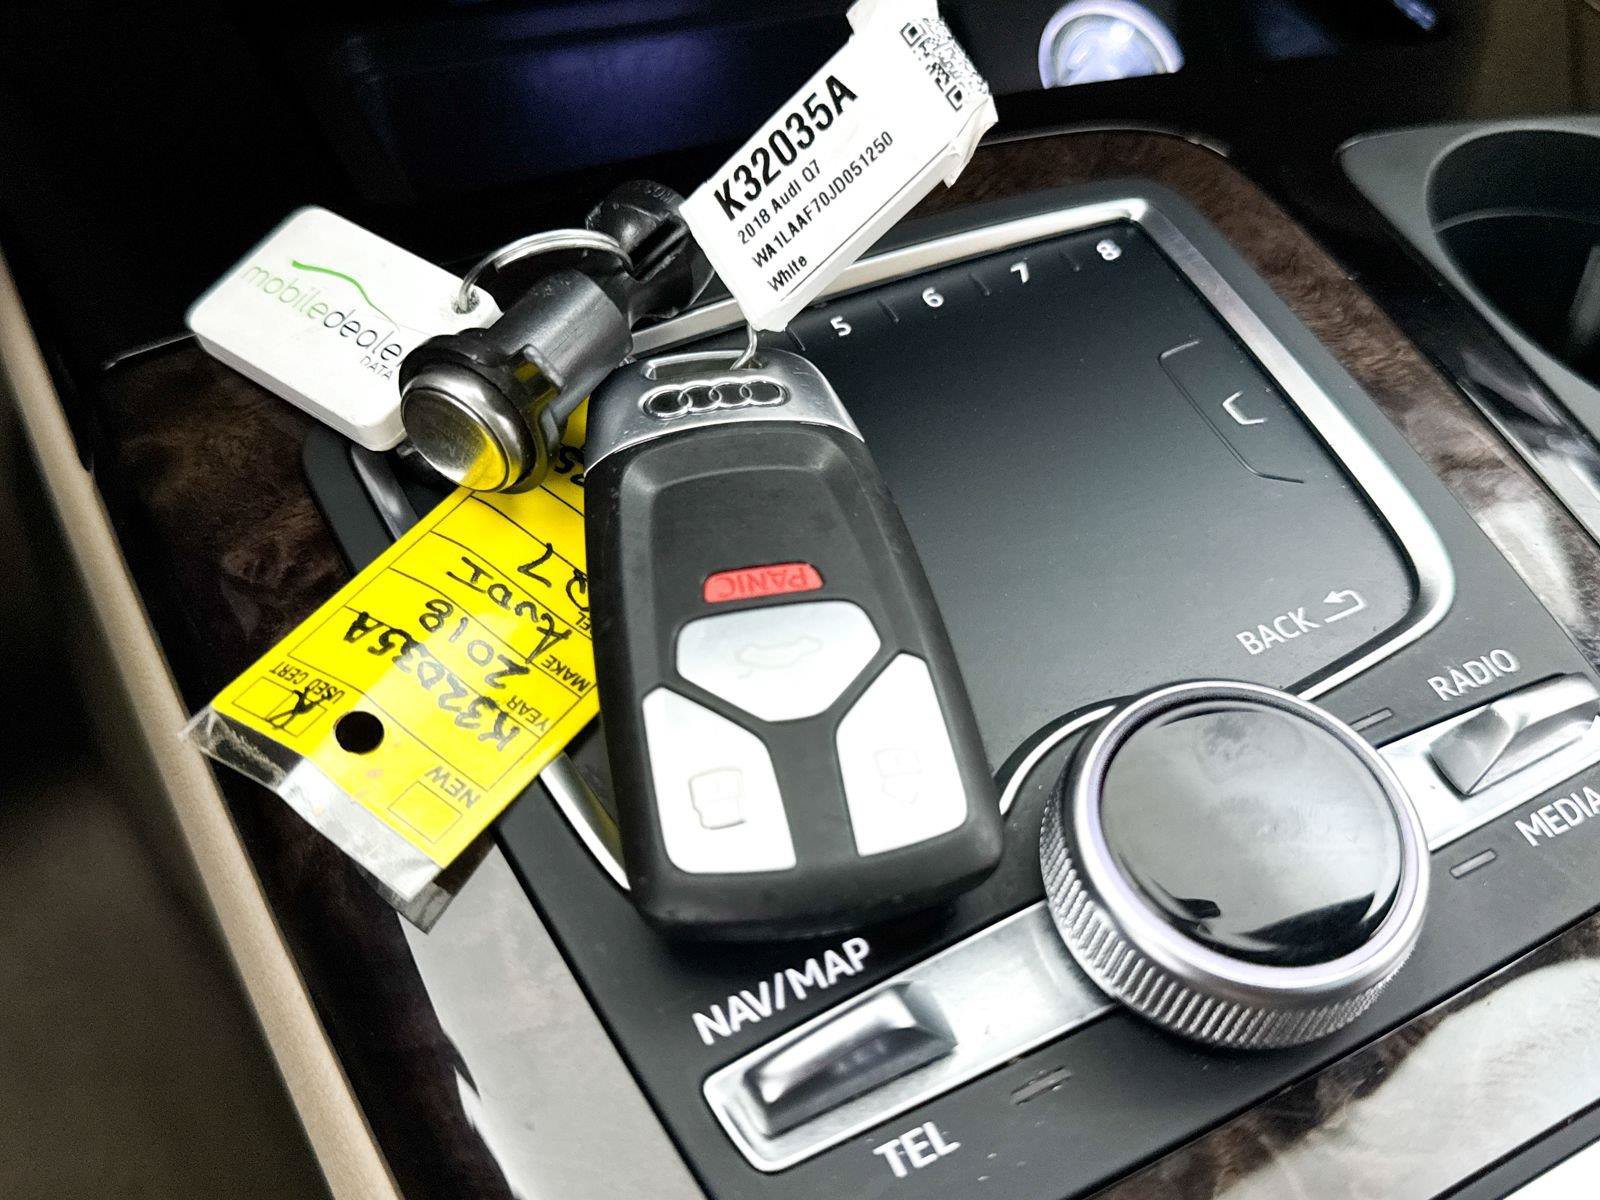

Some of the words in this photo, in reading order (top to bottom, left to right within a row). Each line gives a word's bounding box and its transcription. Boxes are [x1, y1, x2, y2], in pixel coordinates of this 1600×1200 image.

[713, 75, 858, 220] K32035A
[738, 209, 771, 245] 2018
[772, 182, 803, 216] Audi
[802, 159, 822, 185] Q7
[753, 131, 894, 269] WA1LAAF70JD051250
[1096, 239, 1121, 261] 8
[767, 254, 808, 292] White
[1010, 260, 1030, 284] 7
[922, 286, 944, 308] 6
[830, 316, 852, 338] 5
[360, 355, 394, 381] DATA
[717, 566, 808, 598] PANIC
[418, 598, 530, 690] 2018
[1236, 607, 1320, 655] BACK
[269, 661, 309, 685] CERT
[306, 678, 345, 704] USED
[343, 611, 520, 751] K32035A
[540, 654, 592, 692] MAKE
[1427, 649, 1520, 701] RADIO
[506, 694, 549, 731] YEAR
[424, 765, 480, 810] NEW
[1514, 785, 1600, 847] MEDIA
[691, 937, 870, 1045] NAV/MAP
[872, 1121, 961, 1178] TEL
